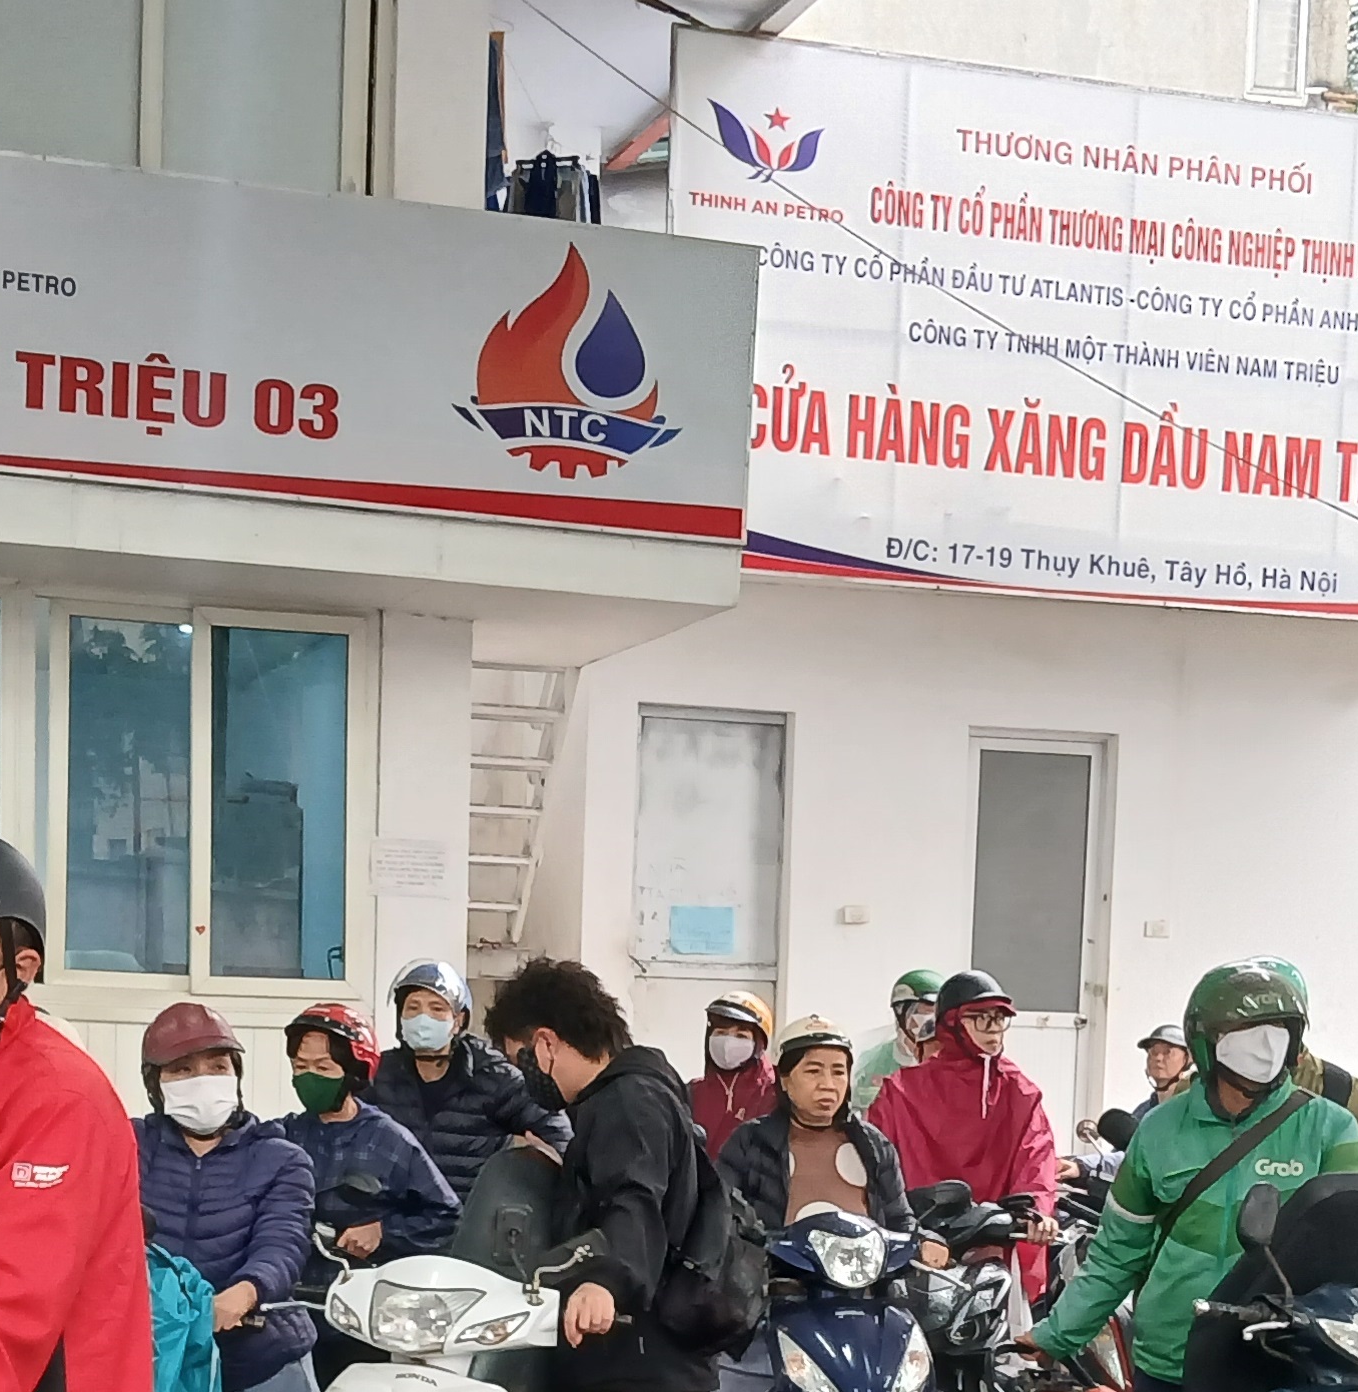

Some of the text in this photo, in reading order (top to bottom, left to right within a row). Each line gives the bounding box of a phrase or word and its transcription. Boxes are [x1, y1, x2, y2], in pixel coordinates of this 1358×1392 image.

[956, 129, 1312, 194] THƯƠNG NHÂN PHÂN PHỐI
[752, 200, 778, 216] AN
[784, 203, 844, 224] PETRO
[870, 181, 923, 228] CÔNG
[931, 194, 952, 232] TY
[959, 185, 985, 236] CỔ
[990, 192, 1042, 243] PHẦN
[1049, 209, 1122, 253] THƯƠNG
[1129, 218, 1165, 264] MẠI
[1172, 218, 1222, 263] CÔNG
[1228, 228, 1295, 278] NGHIỆP
[1301, 238, 1354, 283] THỊNH
[3, 269, 77, 298] PETRO
[759, 243, 814, 272] CÔNG
[822, 253, 847, 275] TY
[854, 250, 883, 279] CỔ
[999, 274, 1025, 297] TƯ
[1031, 279, 1123, 307] ATLANTIS
[1198, 297, 1223, 317] TY
[1229, 291, 1256, 321] CỔ
[1319, 312, 1358, 332] ANH
[909, 319, 1339, 387] CÔNG TY TNHH MỘT THÀNH VIÊN NAM TRIỆU
[16, 350, 228, 436] TRIỆU
[253, 378, 340, 440] 03
[522, 409, 609, 445] NTC
[751, 364, 830, 456] CỬA
[846, 383, 970, 470] HÀNG
[984, 397, 1106, 481] XĂNG
[1121, 402, 1208, 490] DẦU
[1221, 430, 1321, 500] NAM
[886, 537, 1337, 594] Đ/C: 17-19 Thụy Khuê, Tây Hồ, Hà Nội
[1255, 1158, 1304, 1177] Grab
